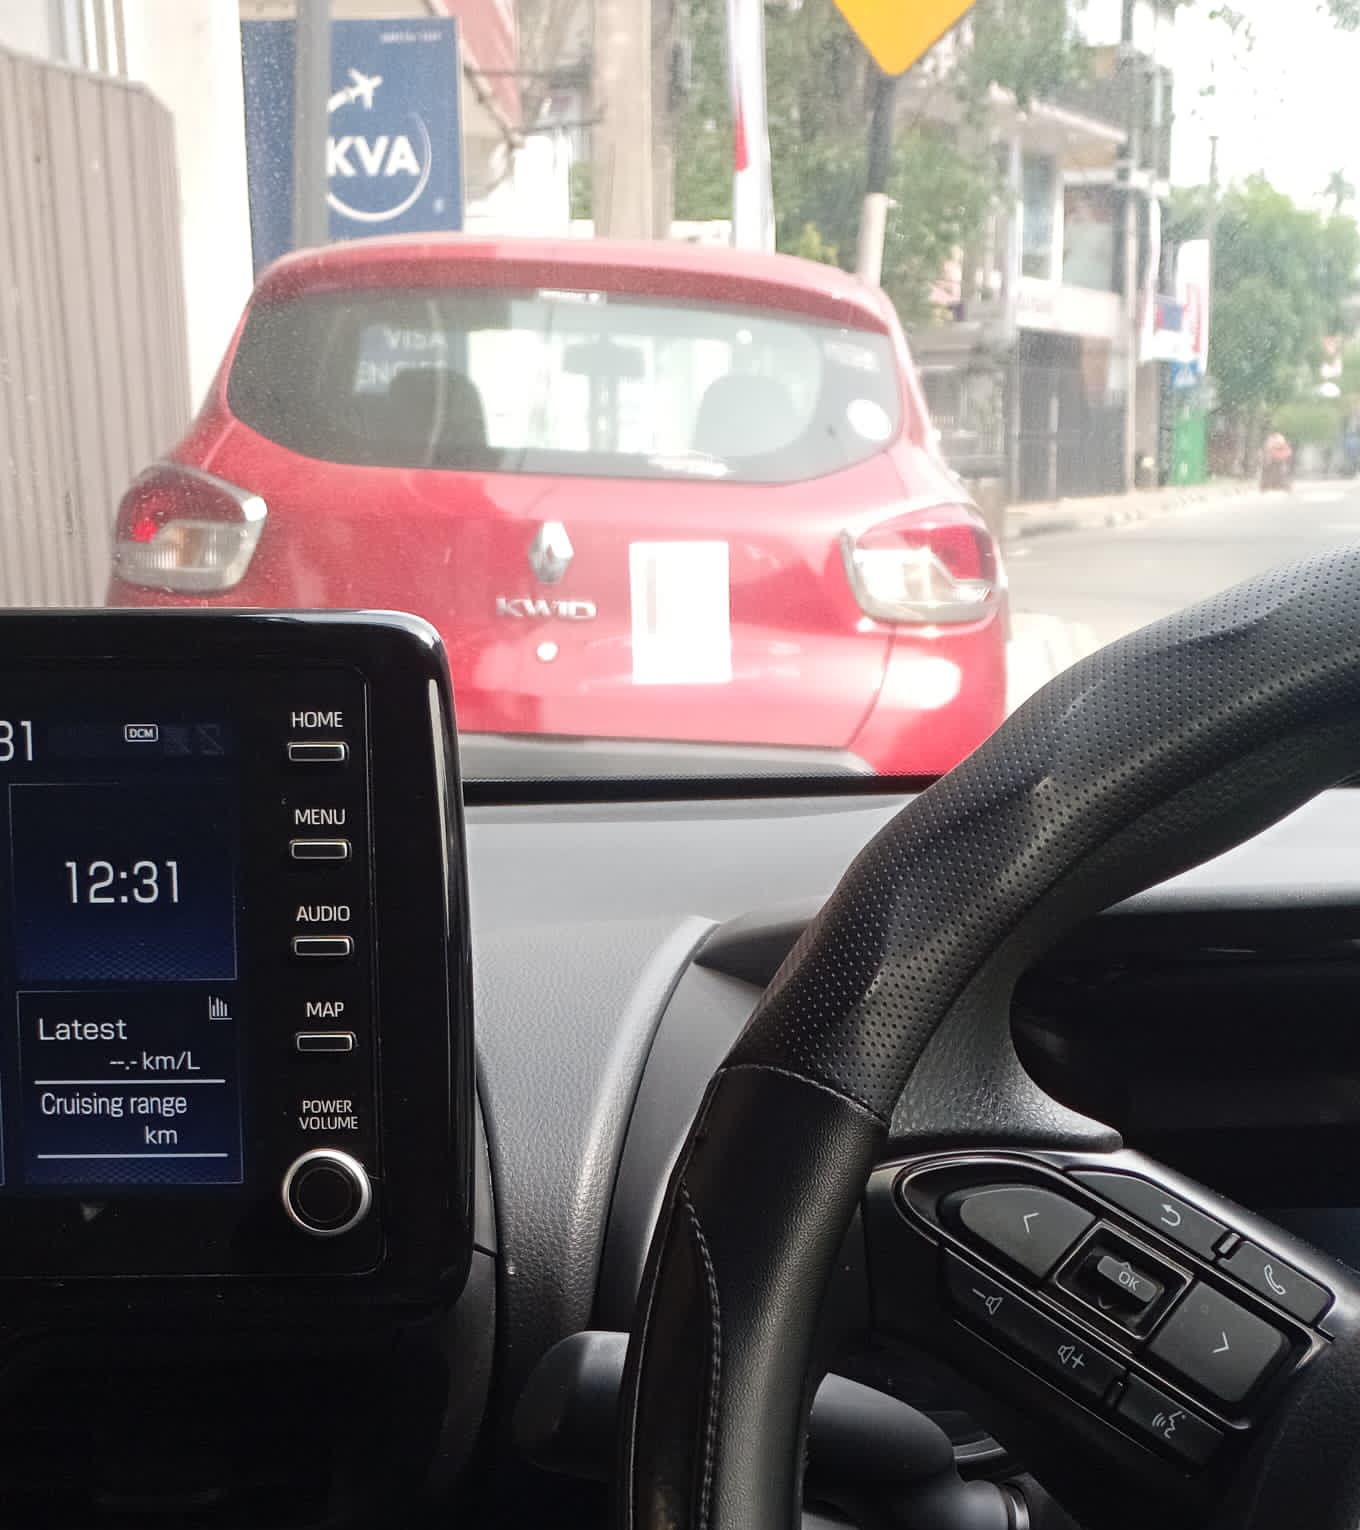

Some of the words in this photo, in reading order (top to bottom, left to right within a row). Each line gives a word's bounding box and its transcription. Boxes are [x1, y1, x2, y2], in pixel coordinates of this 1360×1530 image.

[325, 135, 421, 177] KVA
[495, 597, 597, 618] KWID
[291, 711, 344, 728] HOME
[128, 728, 154, 739] DCM
[294, 808, 346, 825] MENU
[65, 860, 180, 904] 12:31
[295, 904, 351, 922] AUDIO
[305, 1001, 345, 1018] MAP
[38, 1018, 128, 1042] Latest
[142, 1050, 201, 1071] km/L
[40, 1092, 124, 1119] Cruising
[129, 1095, 188, 1118] range
[302, 1099, 353, 1114] POWER
[298, 1115, 359, 1131] VOLUME
[144, 1125, 179, 1146] km
[1118, 1271, 1140, 1291] OK
